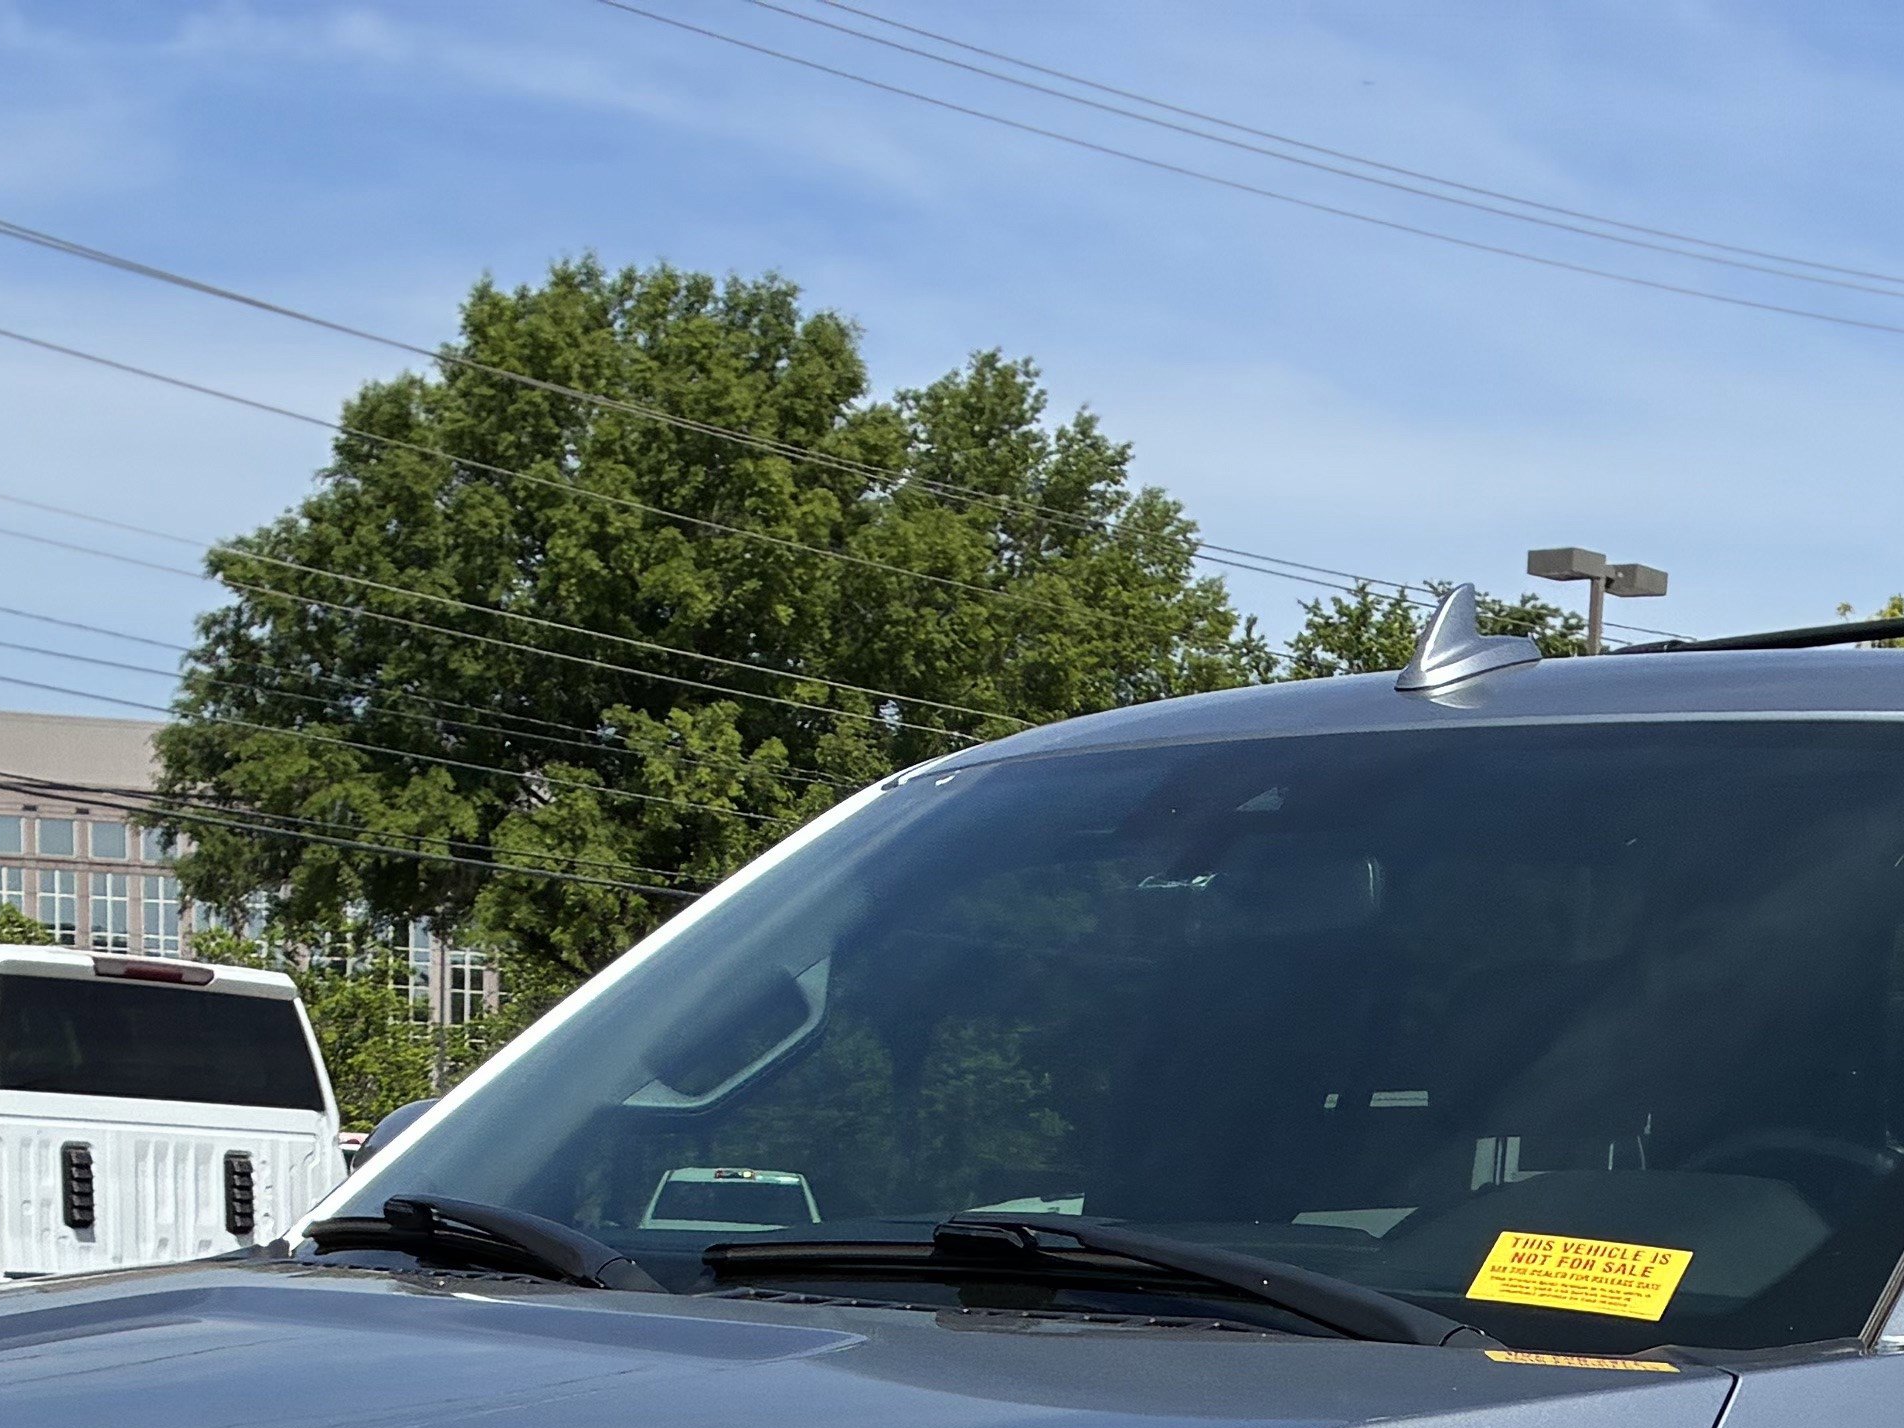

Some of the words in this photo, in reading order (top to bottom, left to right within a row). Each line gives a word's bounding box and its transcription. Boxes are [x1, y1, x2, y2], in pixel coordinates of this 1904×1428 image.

[1511, 1236, 1555, 1251] THIS
[1562, 1242, 1647, 1261] VEHICLE
[1651, 1252, 1672, 1265] IS
[1510, 1252, 1552, 1266] NOT
[1557, 1256, 1596, 1271] FOR
[1602, 1261, 1655, 1278] SALE
